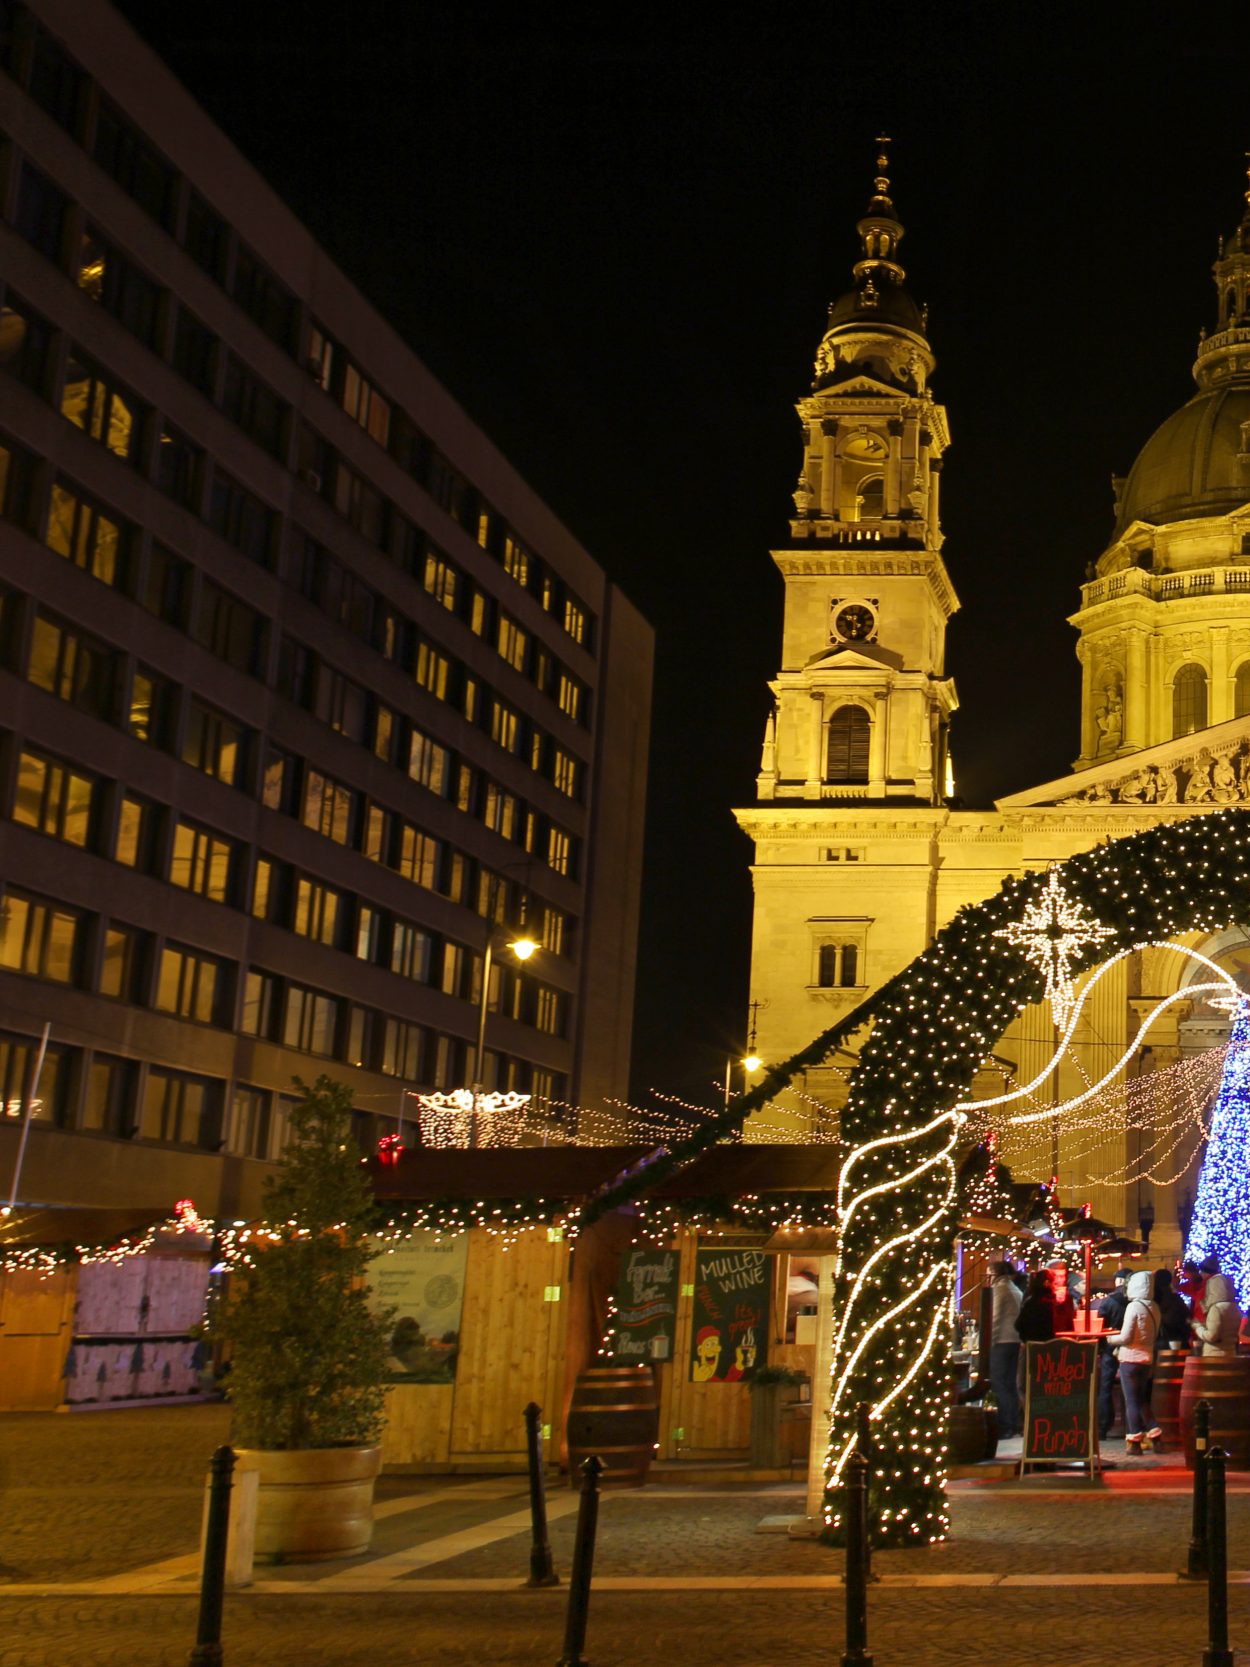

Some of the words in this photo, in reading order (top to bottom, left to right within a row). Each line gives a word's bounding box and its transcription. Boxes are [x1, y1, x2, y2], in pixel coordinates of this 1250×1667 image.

[700, 1251, 765, 1281] MULLED
[718, 1267, 764, 1293] WINE
[1036, 1345, 1087, 1382] Mulled
[1043, 1380, 1072, 1396] wine
[1031, 1416, 1087, 1453] Punch
